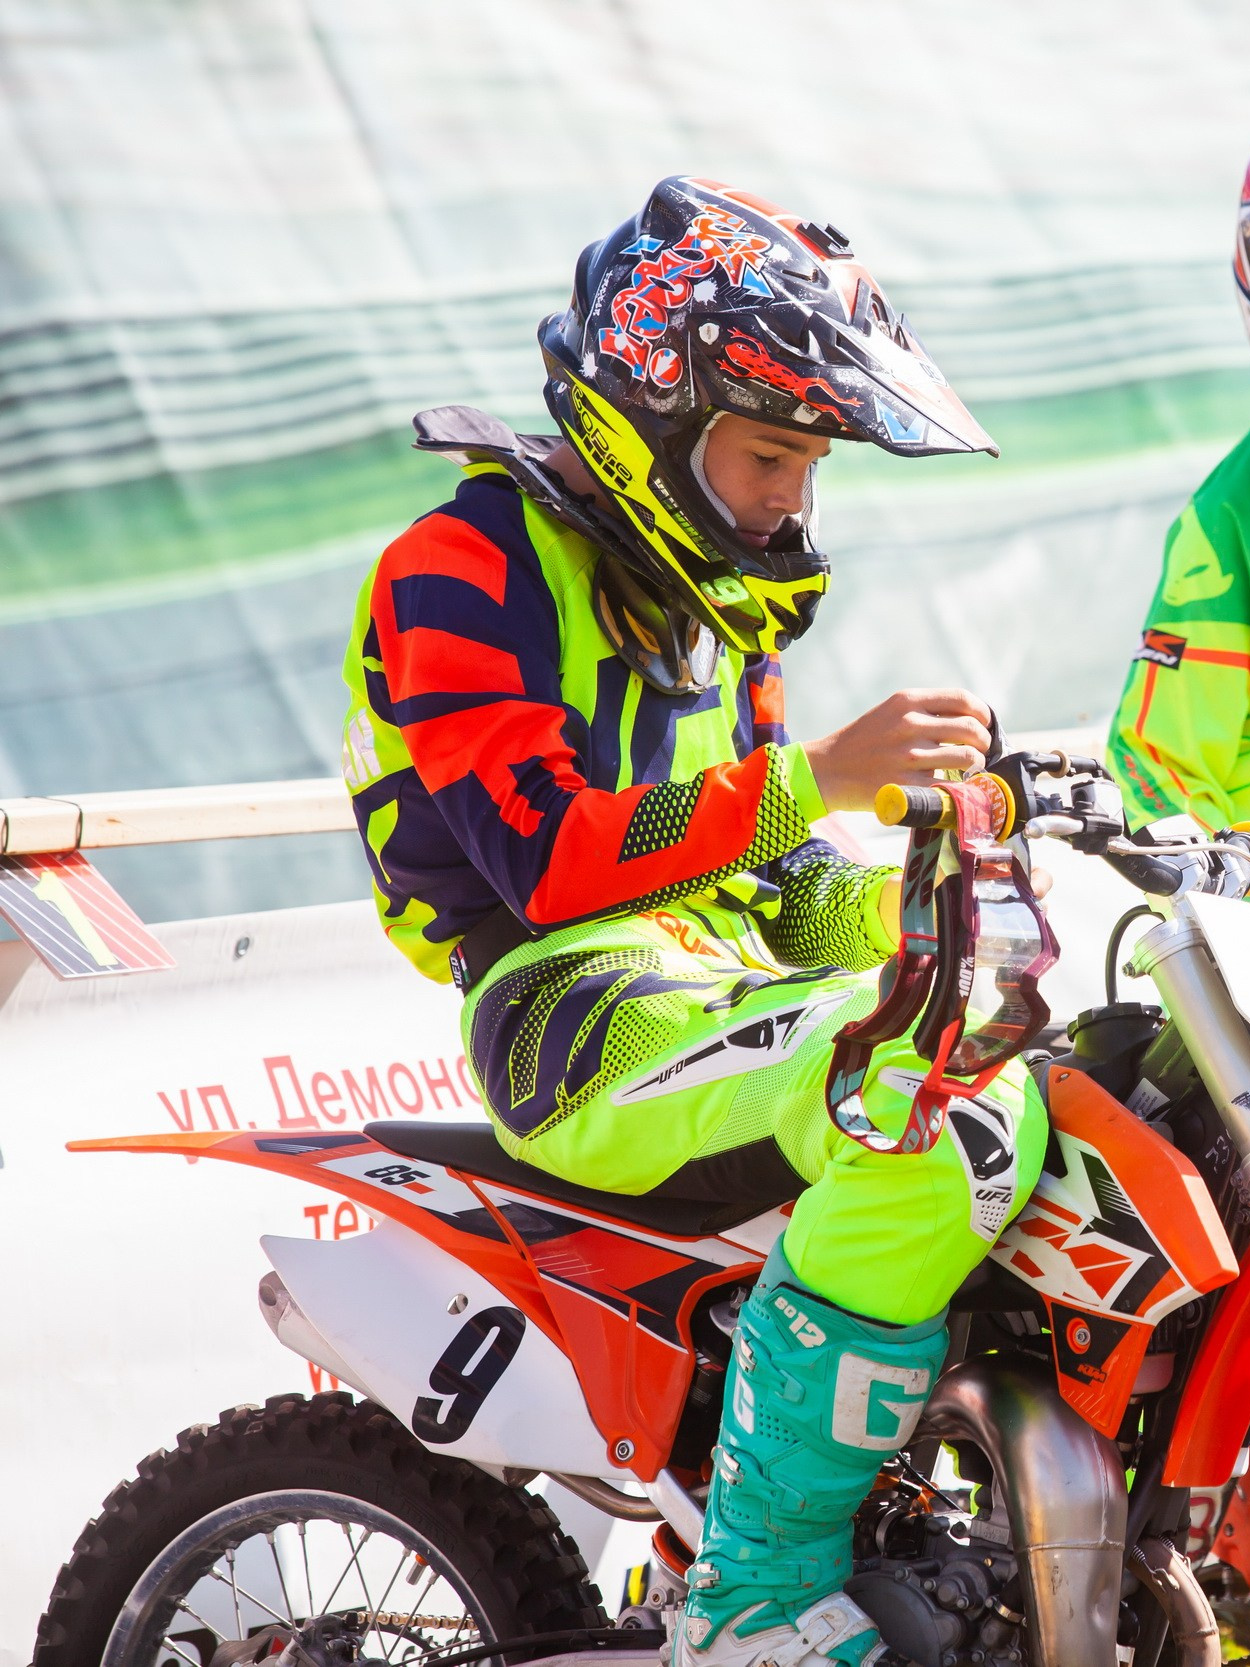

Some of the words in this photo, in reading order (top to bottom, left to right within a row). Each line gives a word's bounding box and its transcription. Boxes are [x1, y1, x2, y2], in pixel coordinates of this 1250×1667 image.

[957, 956, 975, 999] 100%
[658, 1060, 684, 1085] UFO
[976, 1188, 1014, 1205] UFO
[412, 1306, 527, 1445] 9
[1076, 1363, 1108, 1383] KTM
